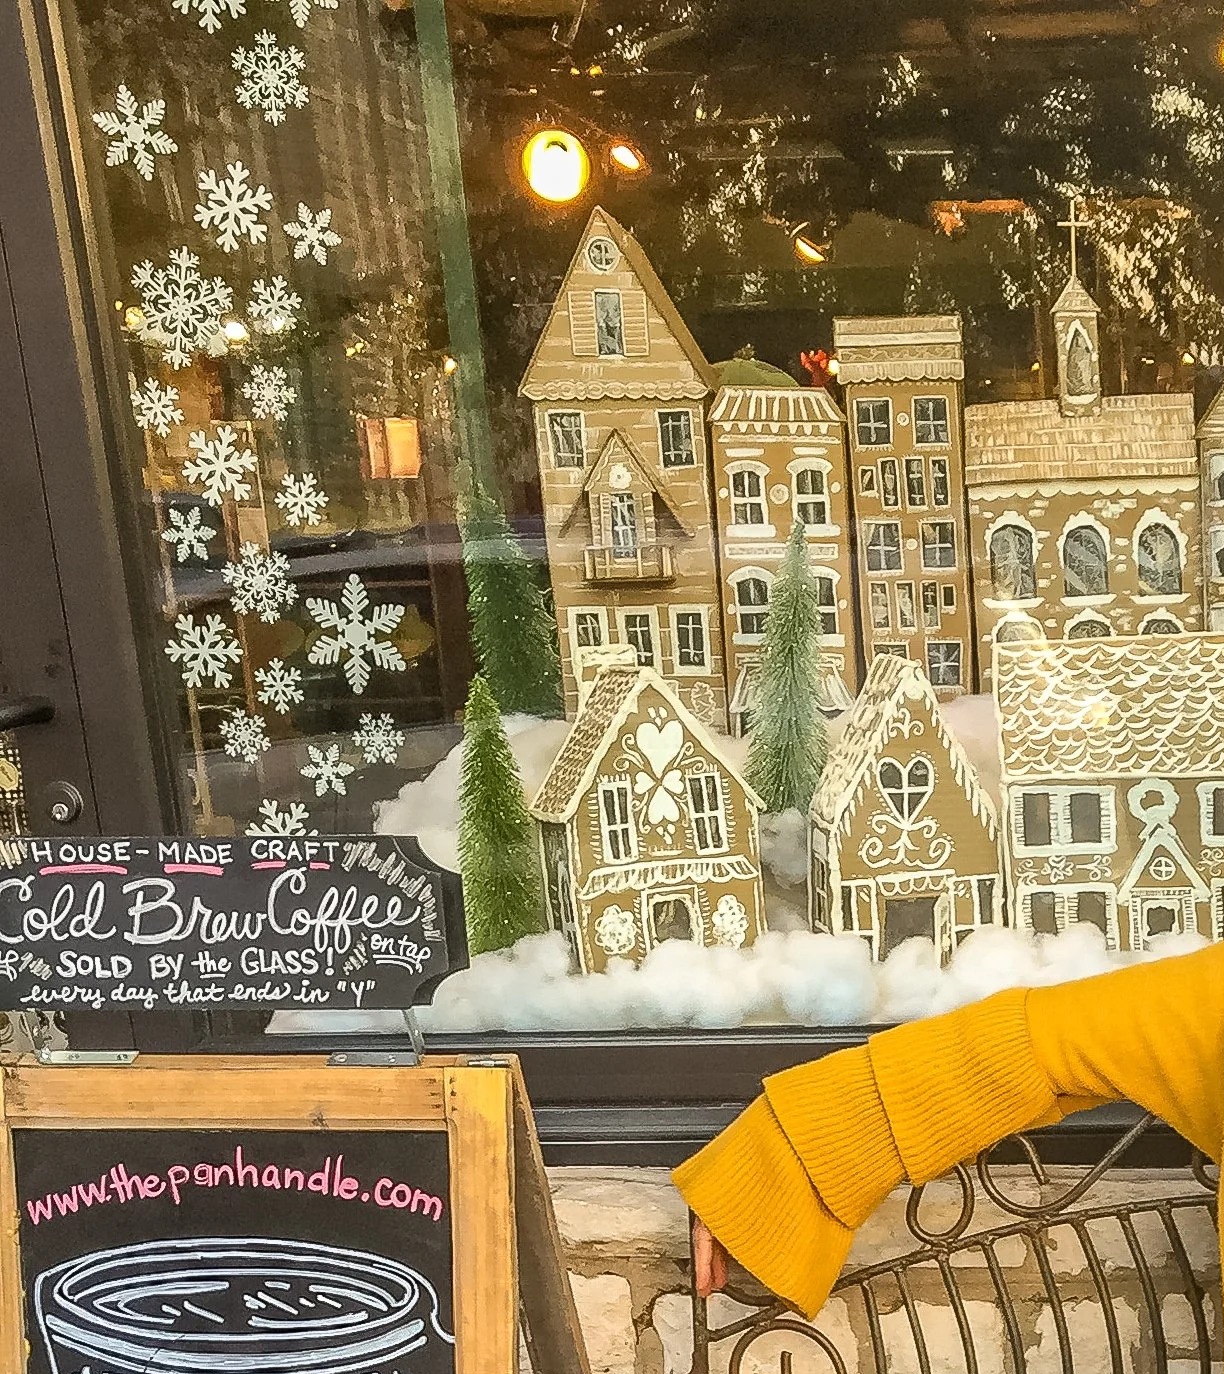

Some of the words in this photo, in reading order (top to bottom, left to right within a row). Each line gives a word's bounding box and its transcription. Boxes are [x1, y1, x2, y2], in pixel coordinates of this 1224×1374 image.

[250, 838, 340, 863] CRAFT
[0, 874, 117, 944] Cold
[122, 878, 267, 945] Brew
[267, 866, 422, 955] Coffee
[56, 950, 132, 979] SOLD
[150, 952, 187, 980] BY
[191, 954, 232, 974] the
[240, 946, 335, 977] GLASS!
[370, 933, 396, 955] on
[398, 934, 431, 974] tap
[19, 984, 105, 1009] every
[110, 980, 158, 1009] day
[163, 982, 226, 1004] that
[227, 980, 292, 1004] ends
[293, 983, 330, 1004] in
[26, 1145, 444, 1225] www.thepanhandle.com
